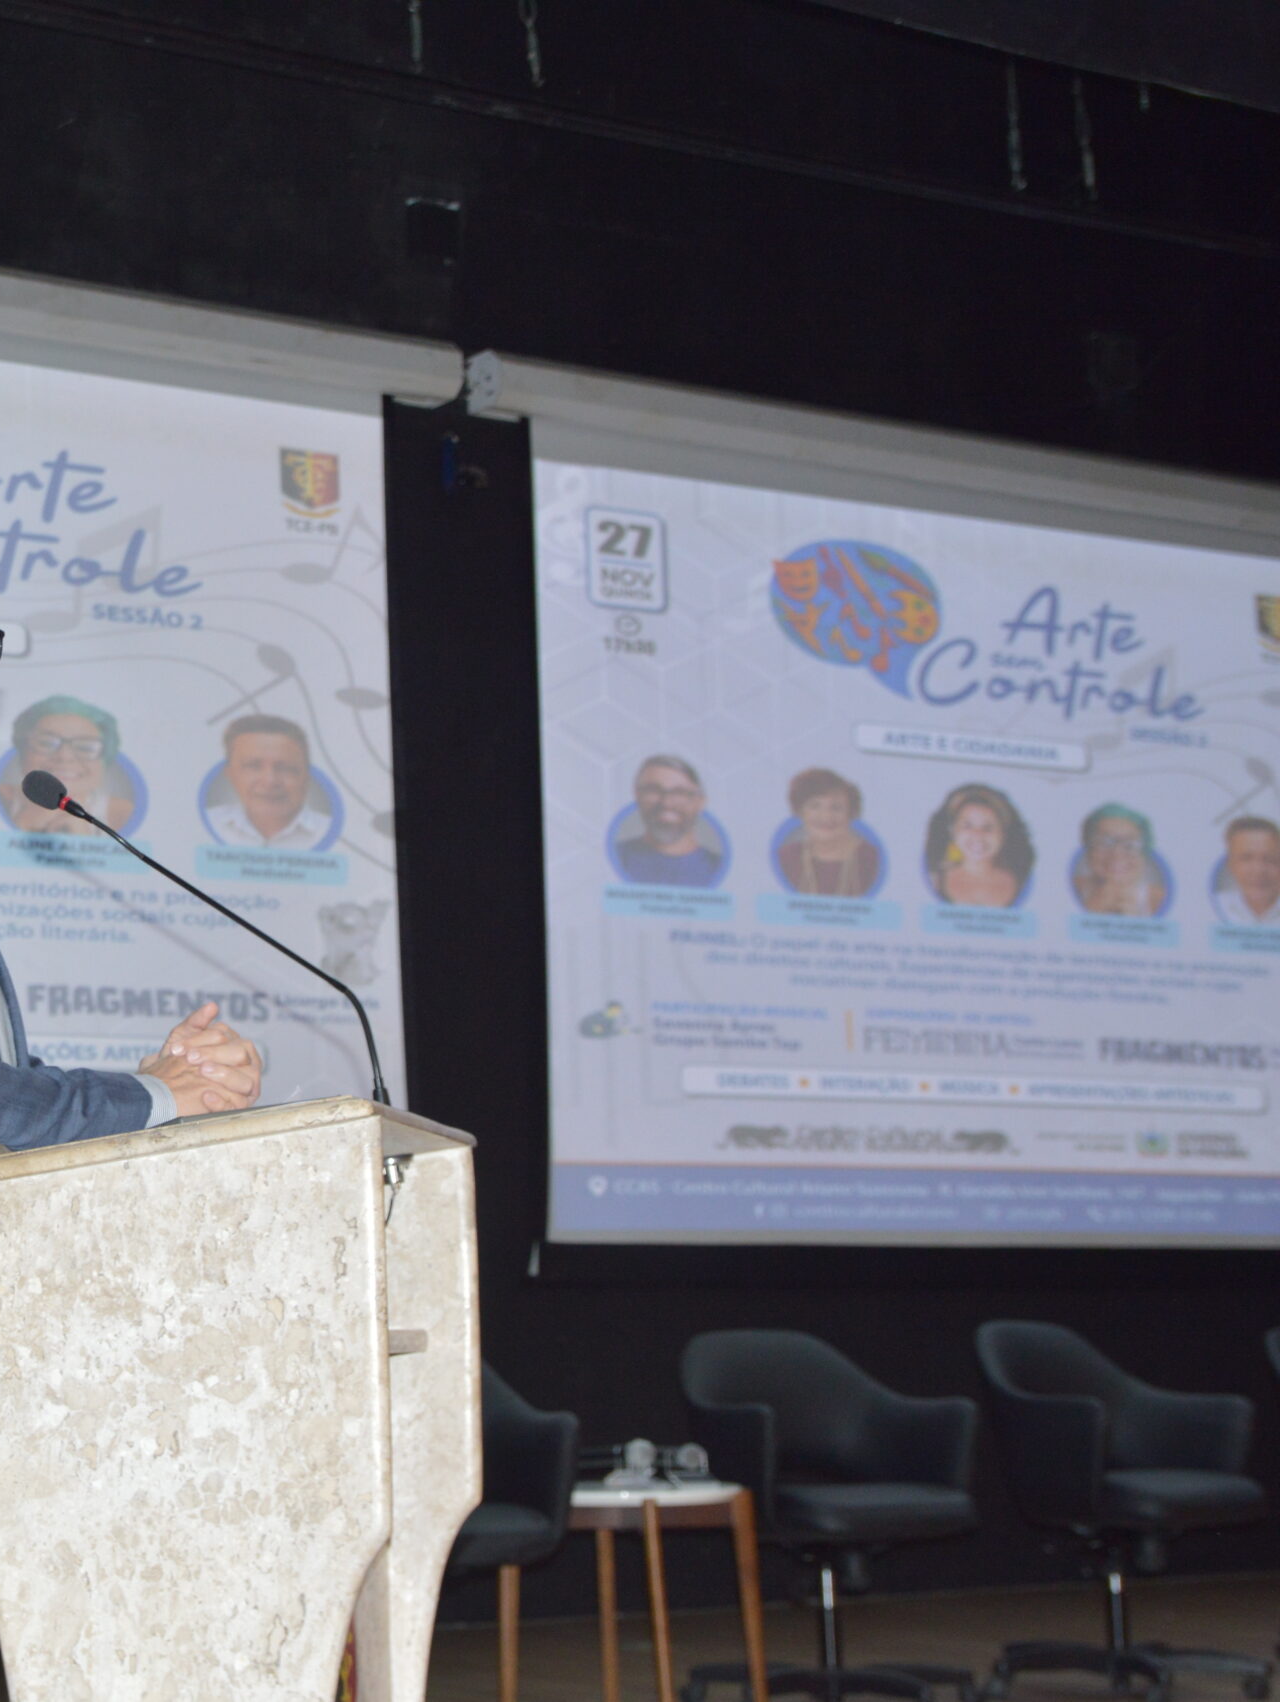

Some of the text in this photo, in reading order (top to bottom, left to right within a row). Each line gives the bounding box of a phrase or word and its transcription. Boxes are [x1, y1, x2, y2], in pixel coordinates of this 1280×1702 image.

[597, 519, 653, 559] 27
[600, 566, 655, 588] NOV
[91, 602, 202, 629] SESSÃO 2
[999, 583, 1146, 662] Arte
[918, 637, 1206, 721] Controle
[130, 890, 158, 902] na
[26, 984, 270, 1022] FRAGMENTOS
